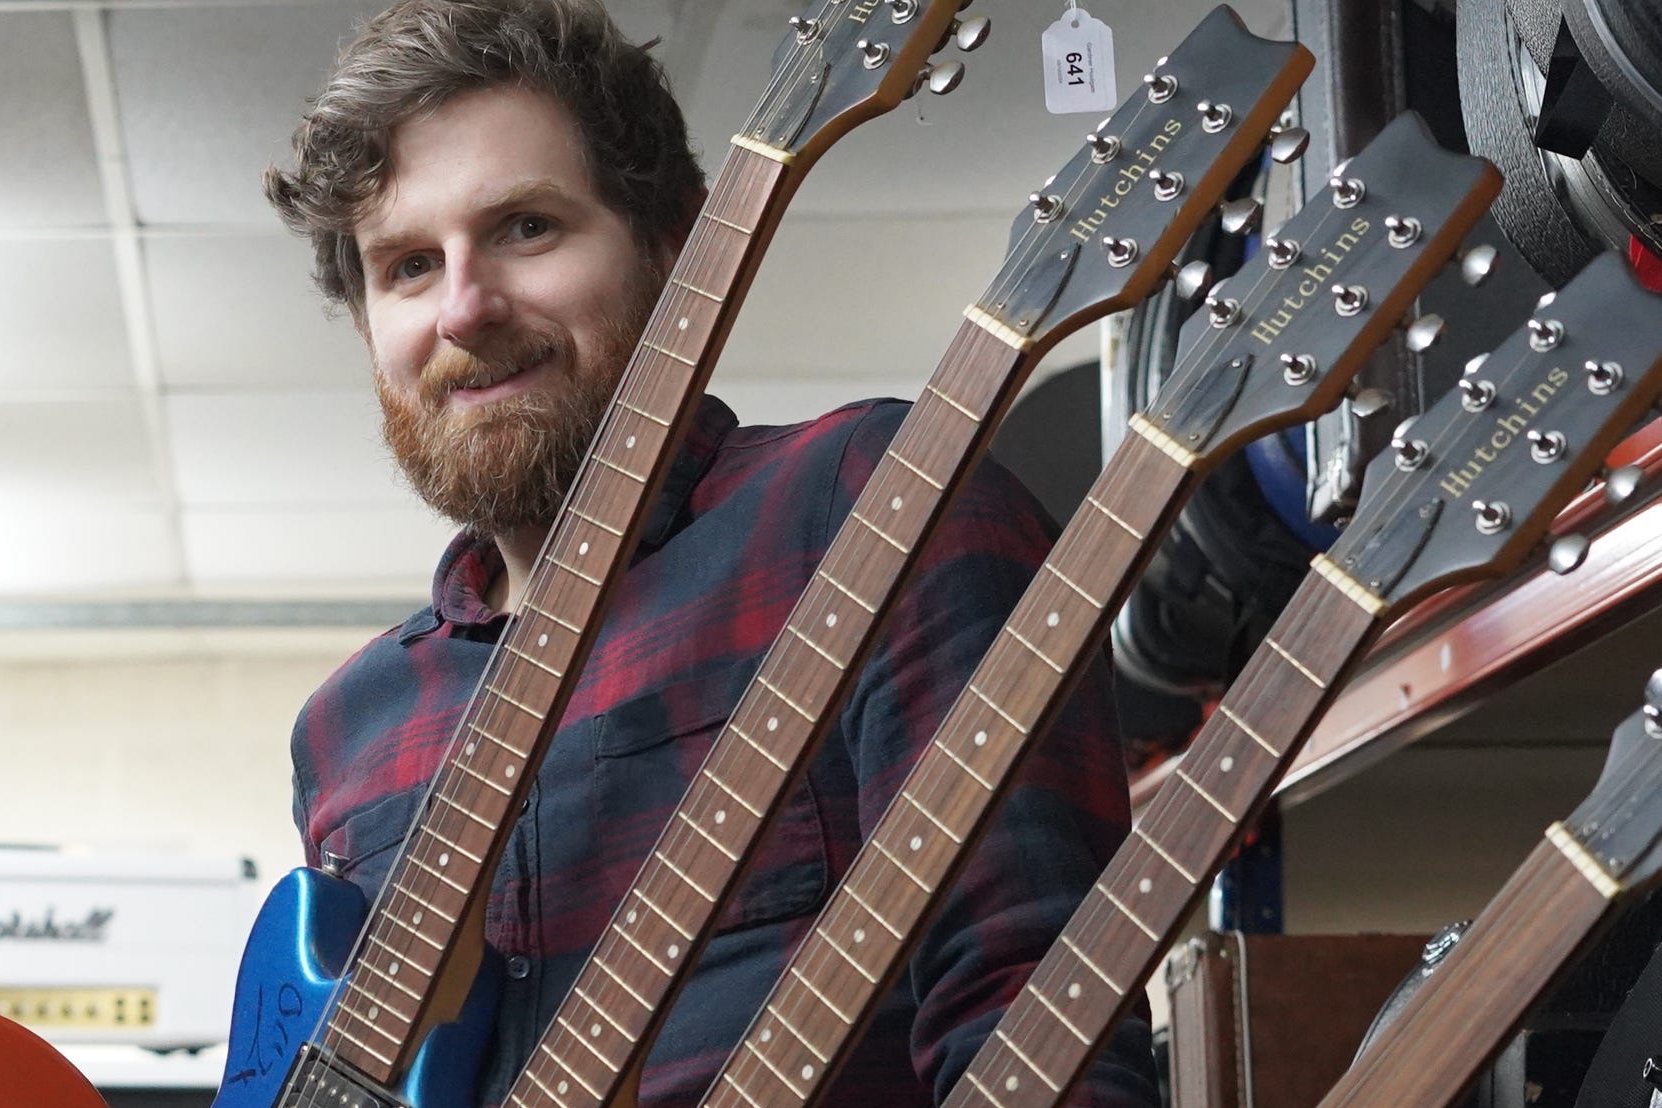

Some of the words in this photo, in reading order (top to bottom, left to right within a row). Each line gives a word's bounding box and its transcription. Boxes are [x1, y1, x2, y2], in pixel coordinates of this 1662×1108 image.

[1066, 52, 1085, 85] 641
[1070, 119, 1182, 242] Hutchins
[1250, 217, 1371, 345] Hutchins
[1440, 367, 1569, 498] Hutchins
